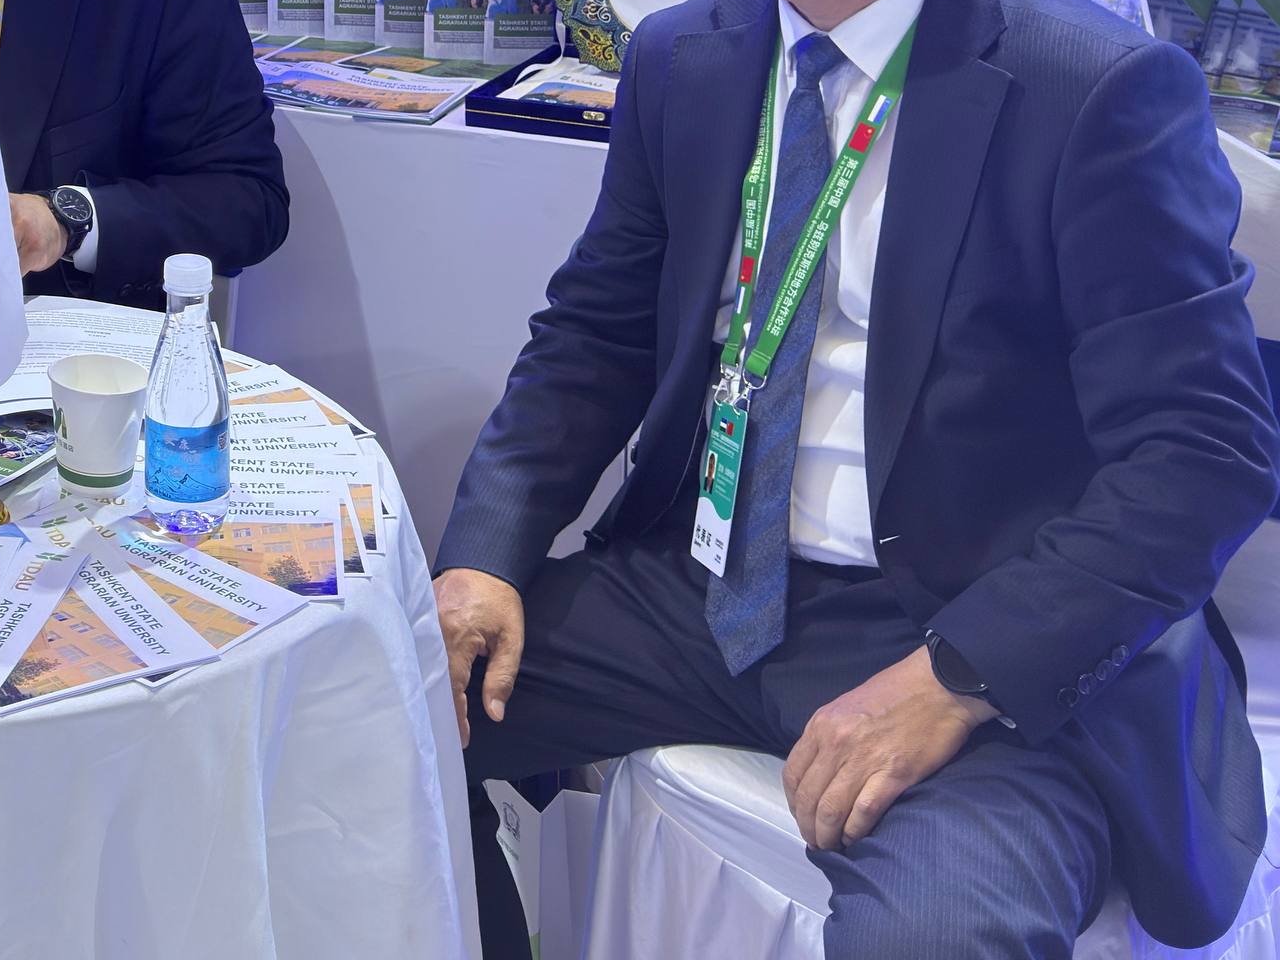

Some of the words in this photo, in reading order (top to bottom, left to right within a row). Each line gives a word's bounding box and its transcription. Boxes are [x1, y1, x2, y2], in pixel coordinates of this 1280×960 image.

[228, 380, 280, 394] VERSITY
[230, 411, 266, 419] TATE
[253, 436, 296, 444] STATE
[255, 441, 339, 452] UNIVERSITY
[270, 460, 315, 469] STATE
[239, 482, 286, 490] STATE
[228, 500, 275, 509] STATE
[228, 508, 320, 517] UNIVERSITY
[43, 528, 73, 549] TDA
[133, 537, 200, 572] TASHKENT
[199, 566, 242, 590] STATE
[14, 560, 46, 592] TDAU
[120, 543, 186, 578] AGRARIAN
[188, 574, 269, 613] UNIVERSITY
[89, 559, 137, 604] TASHKENT
[130, 602, 163, 631] STATE
[78, 565, 121, 609] GRARIAN
[115, 608, 170, 656] UNIVERSITY
